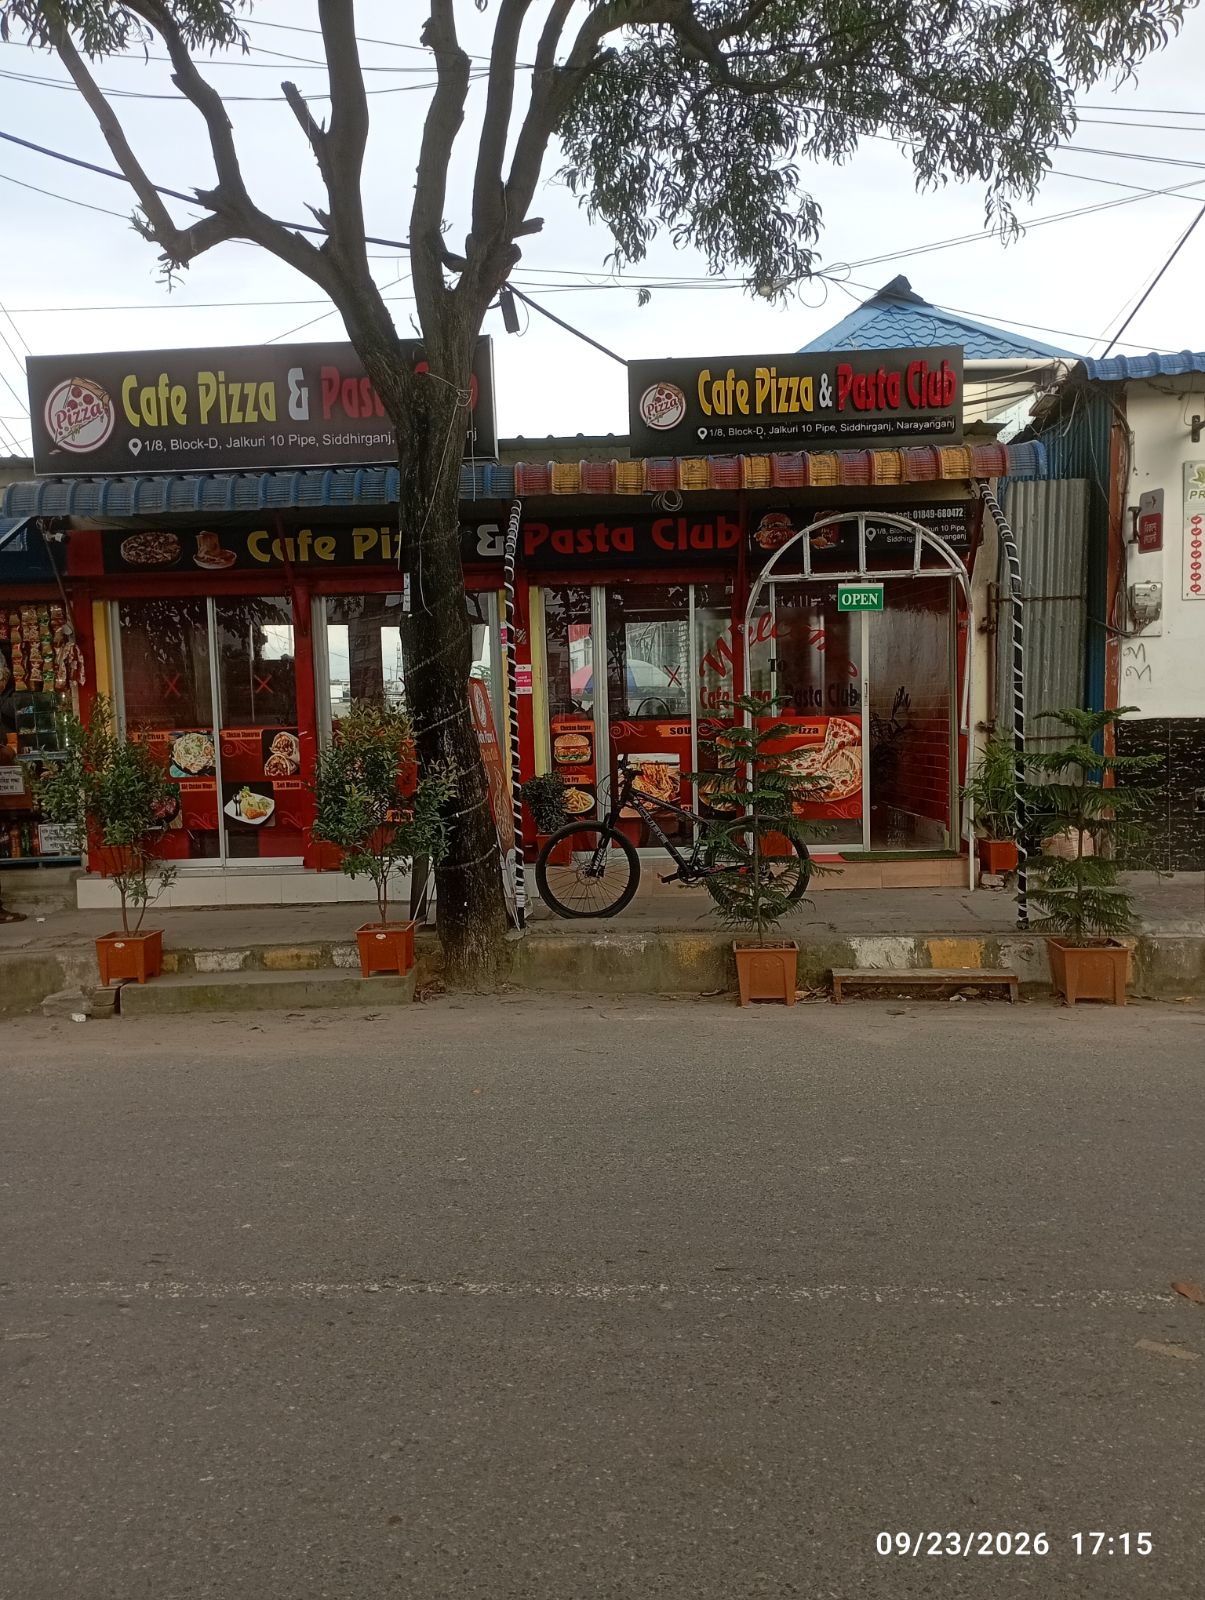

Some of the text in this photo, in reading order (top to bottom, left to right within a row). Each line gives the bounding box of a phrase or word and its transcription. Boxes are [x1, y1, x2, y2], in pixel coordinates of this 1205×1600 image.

[122, 366, 385, 427] Cafe Pizza & Pas
[697, 359, 956, 416] Cafe Pizza & Pasta Club
[55, 402, 104, 430] Pizza
[645, 397, 679, 414] Pizza
[709, 417, 955, 438] 1/8, Block-D, Jalkuri 10 Pipe, Siddhirganj, Narayanganj
[144, 432, 395, 452] 1/8, Block-D, Jalkuri 10 Pipe, Siddhirganj,
[247, 529, 337, 563] Cafe
[476, 515, 741, 556] & Pasta Club
[841, 593, 879, 606] OPEN
[669, 726, 691, 735] SOU
[799, 725, 819, 735] izza
